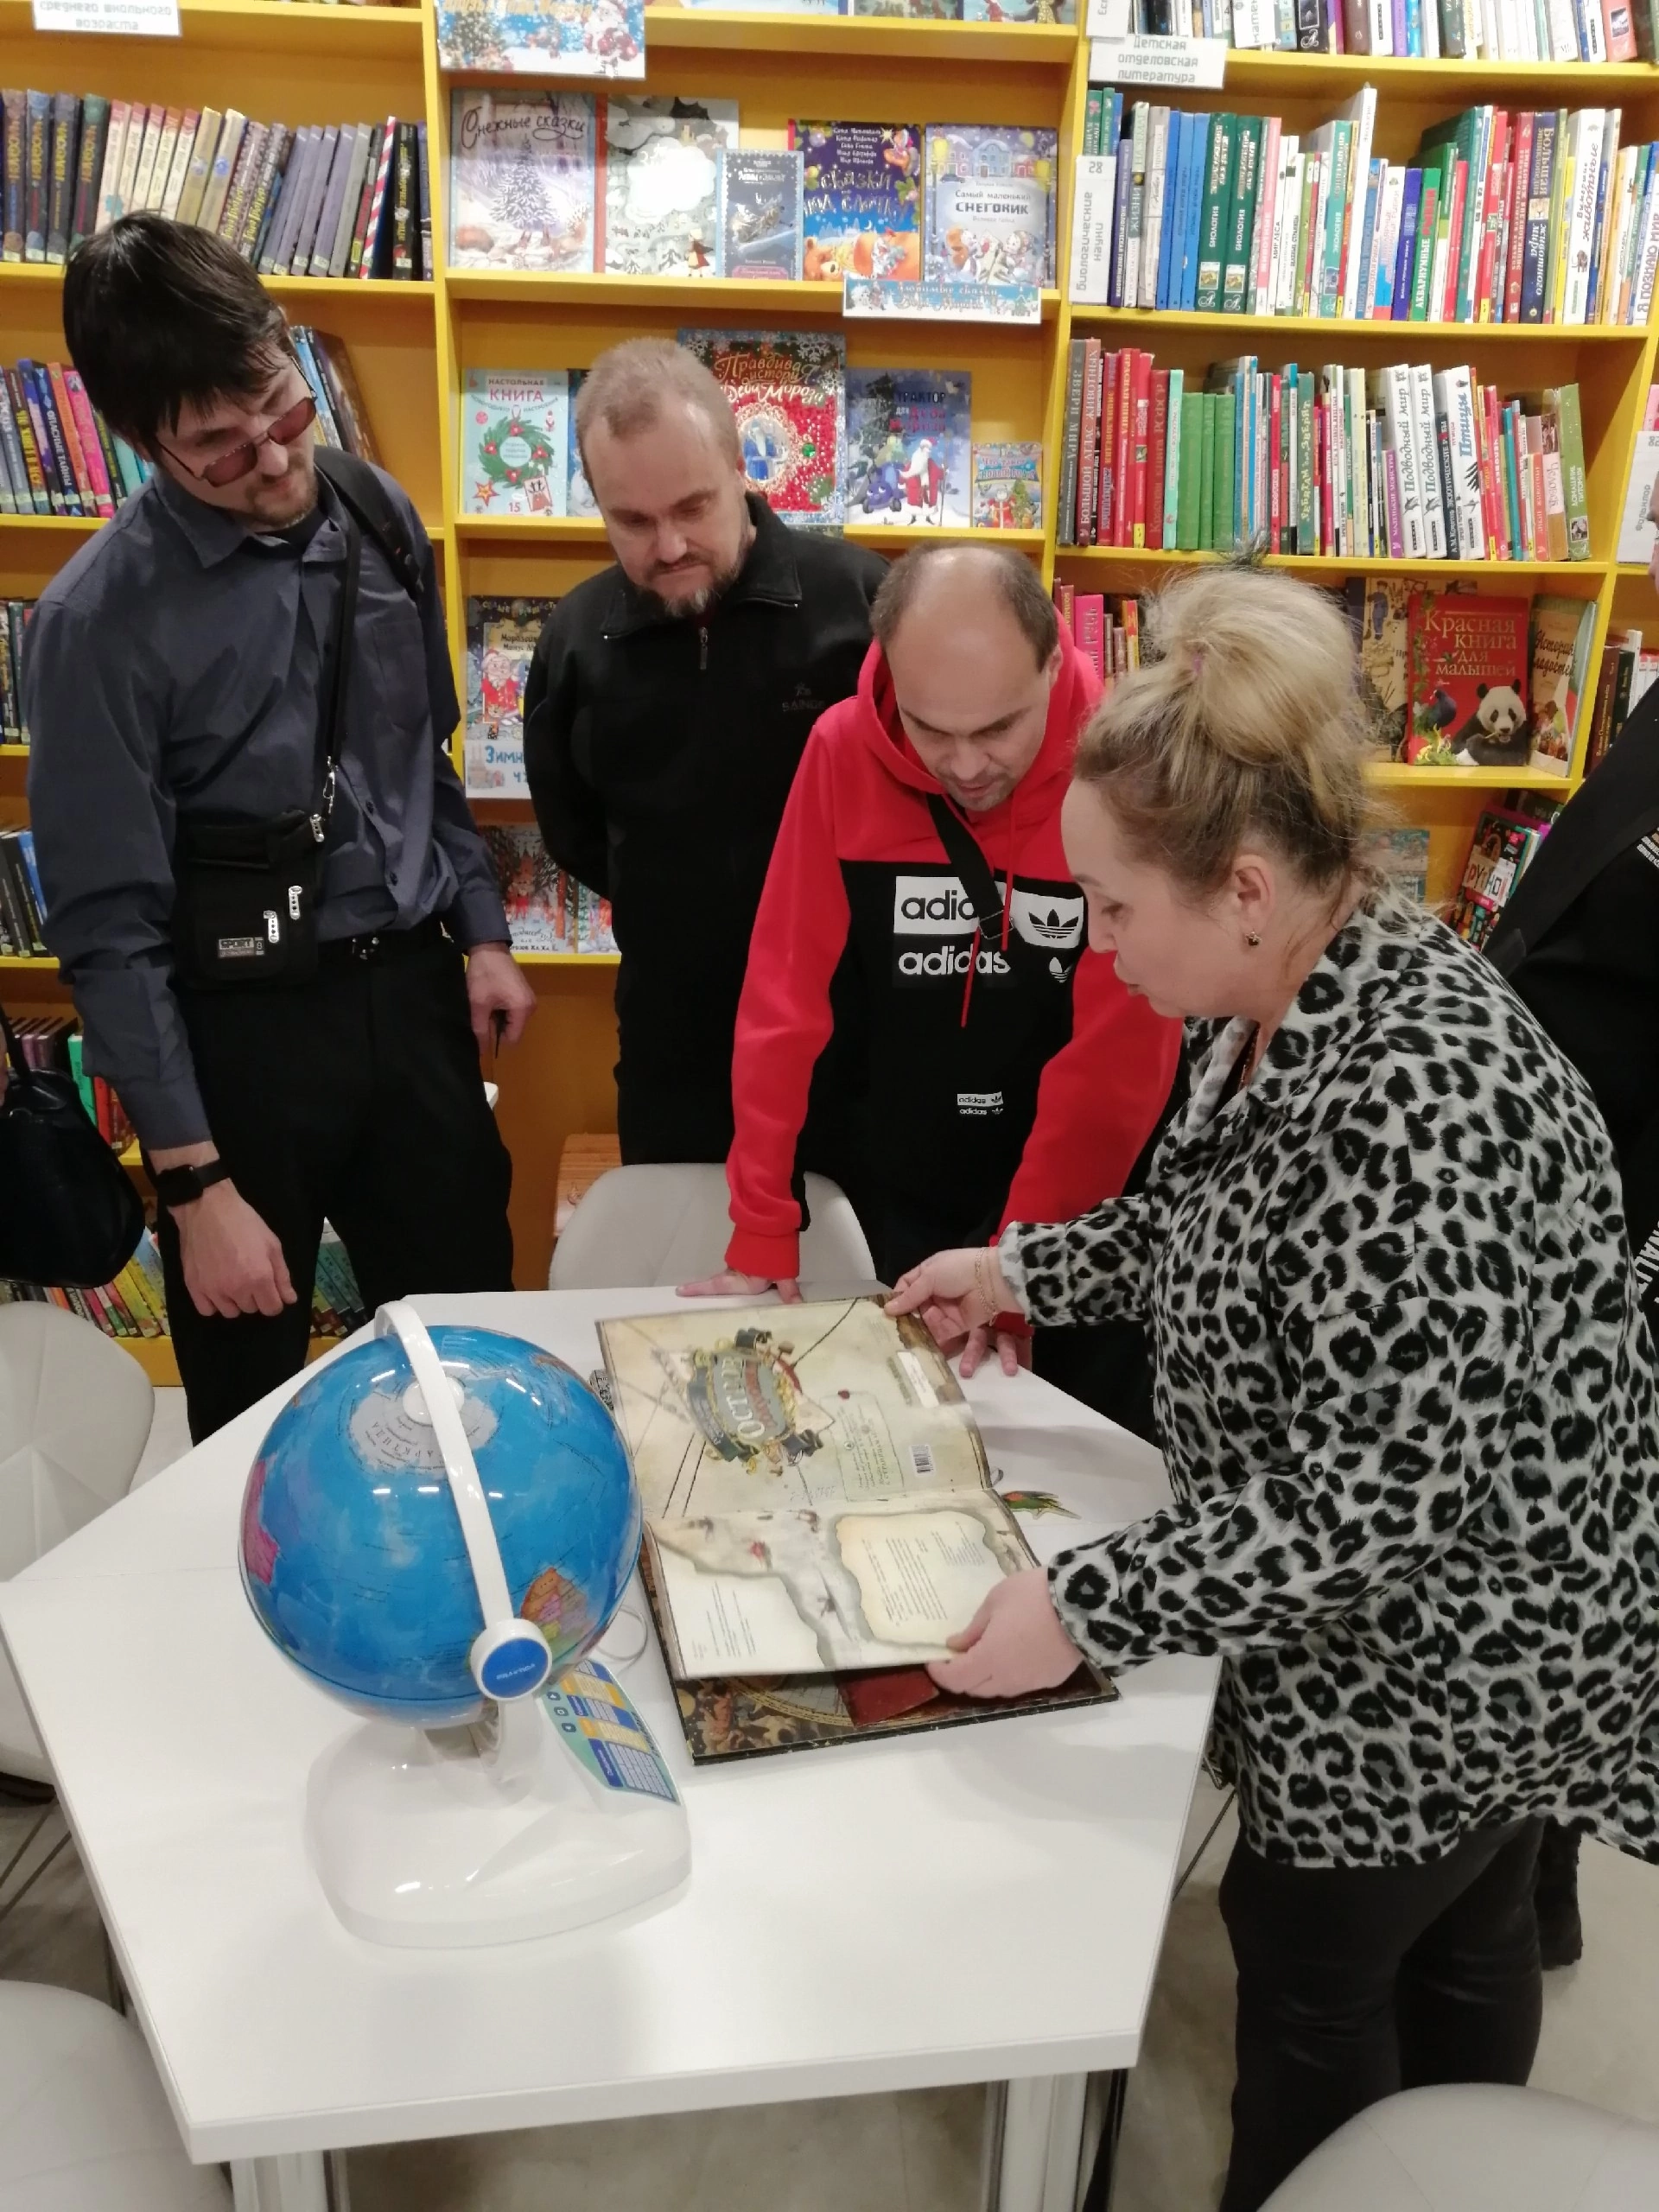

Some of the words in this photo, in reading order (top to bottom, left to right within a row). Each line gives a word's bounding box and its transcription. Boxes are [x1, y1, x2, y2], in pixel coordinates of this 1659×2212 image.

[76, 19, 139, 30] возраста
[1134, 36, 1187, 50] Детская
[1118, 70, 1196, 84] литература
[461, 105, 531, 150] Снежные
[531, 114, 587, 141] сказки
[1539, 127, 1554, 194] Большая
[955, 191, 983, 200] Самый
[1578, 143, 1601, 241] животные
[1093, 221, 1104, 262] науки
[1528, 223, 1539, 257] мира
[1414, 237, 1431, 308] АКВАРИУМНЫЕ
[1535, 223, 1547, 296] животного
[1637, 302, 1649, 313] Я
[1069, 369, 1082, 415] ЗВЕРИ
[1084, 348, 1098, 419] ЖИВОТНЫХ
[1122, 353, 1131, 399] КРАСНАЯ
[490, 388, 543, 402] КНИГА
[1153, 383, 1166, 433] РСФСР
[1396, 387, 1409, 416] мир
[1418, 388, 1431, 416] мир
[1066, 422, 1078, 459] МИРА
[1083, 424, 1094, 461] АТЛАС
[1454, 392, 1473, 457] Птицы
[47, 410, 65, 454] ОПАСНЫЕ
[58, 455, 73, 486] ТАЙНЫ
[1396, 421, 1415, 493] Подводный
[1419, 421, 1435, 493] Подводный
[1441, 445, 1454, 507] ЭКЗОТИЧЕСКИЕ
[508, 503, 520, 512] 15
[1079, 466, 1092, 524] БОЛЬШОЙ
[1389, 493, 1398, 536] МАЛЕНЬКИЕ
[1425, 610, 1516, 638] Красная
[1454, 634, 1516, 650] книга
[1436, 660, 1516, 677] малышей
[1458, 652, 1489, 664] для
[485, 746, 524, 764] Зимн
[901, 890, 979, 920] adi
[899, 944, 1010, 975] adidas
[958, 1096, 987, 1104] adidas
